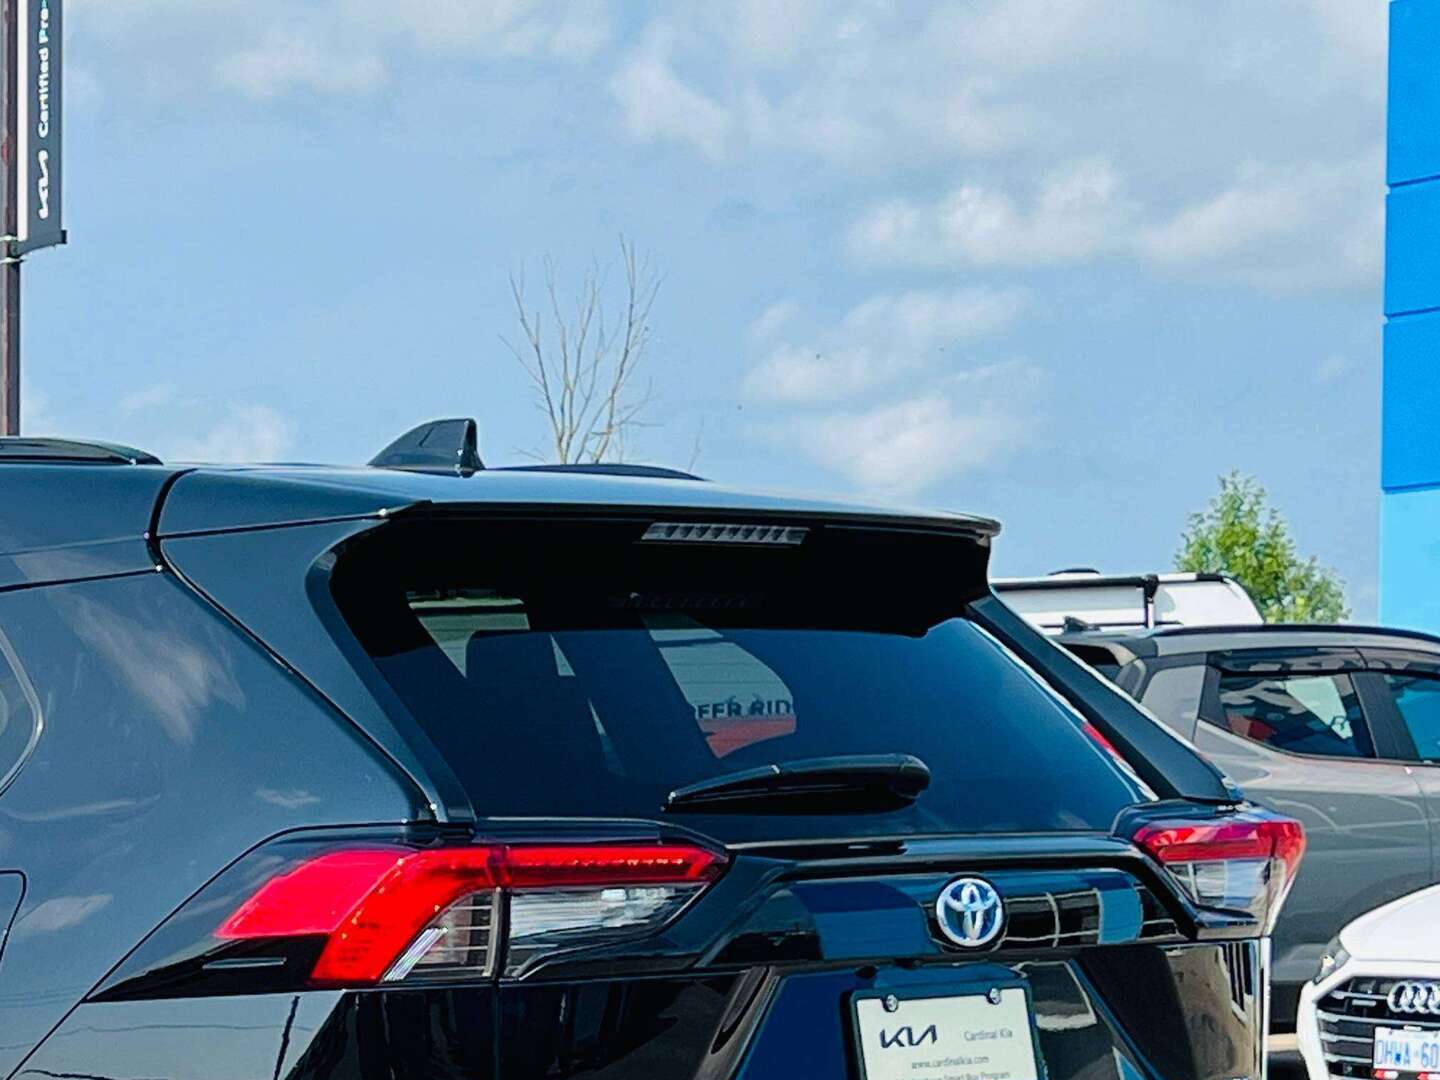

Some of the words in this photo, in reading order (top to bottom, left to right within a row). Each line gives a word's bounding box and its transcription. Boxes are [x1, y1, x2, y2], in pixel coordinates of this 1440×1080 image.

[38, 47, 49, 138] Certified
[879, 1024, 938, 1049] KIA
[964, 1029, 998, 1042] Cardinal
[1000, 1028, 1013, 1039] Kia
